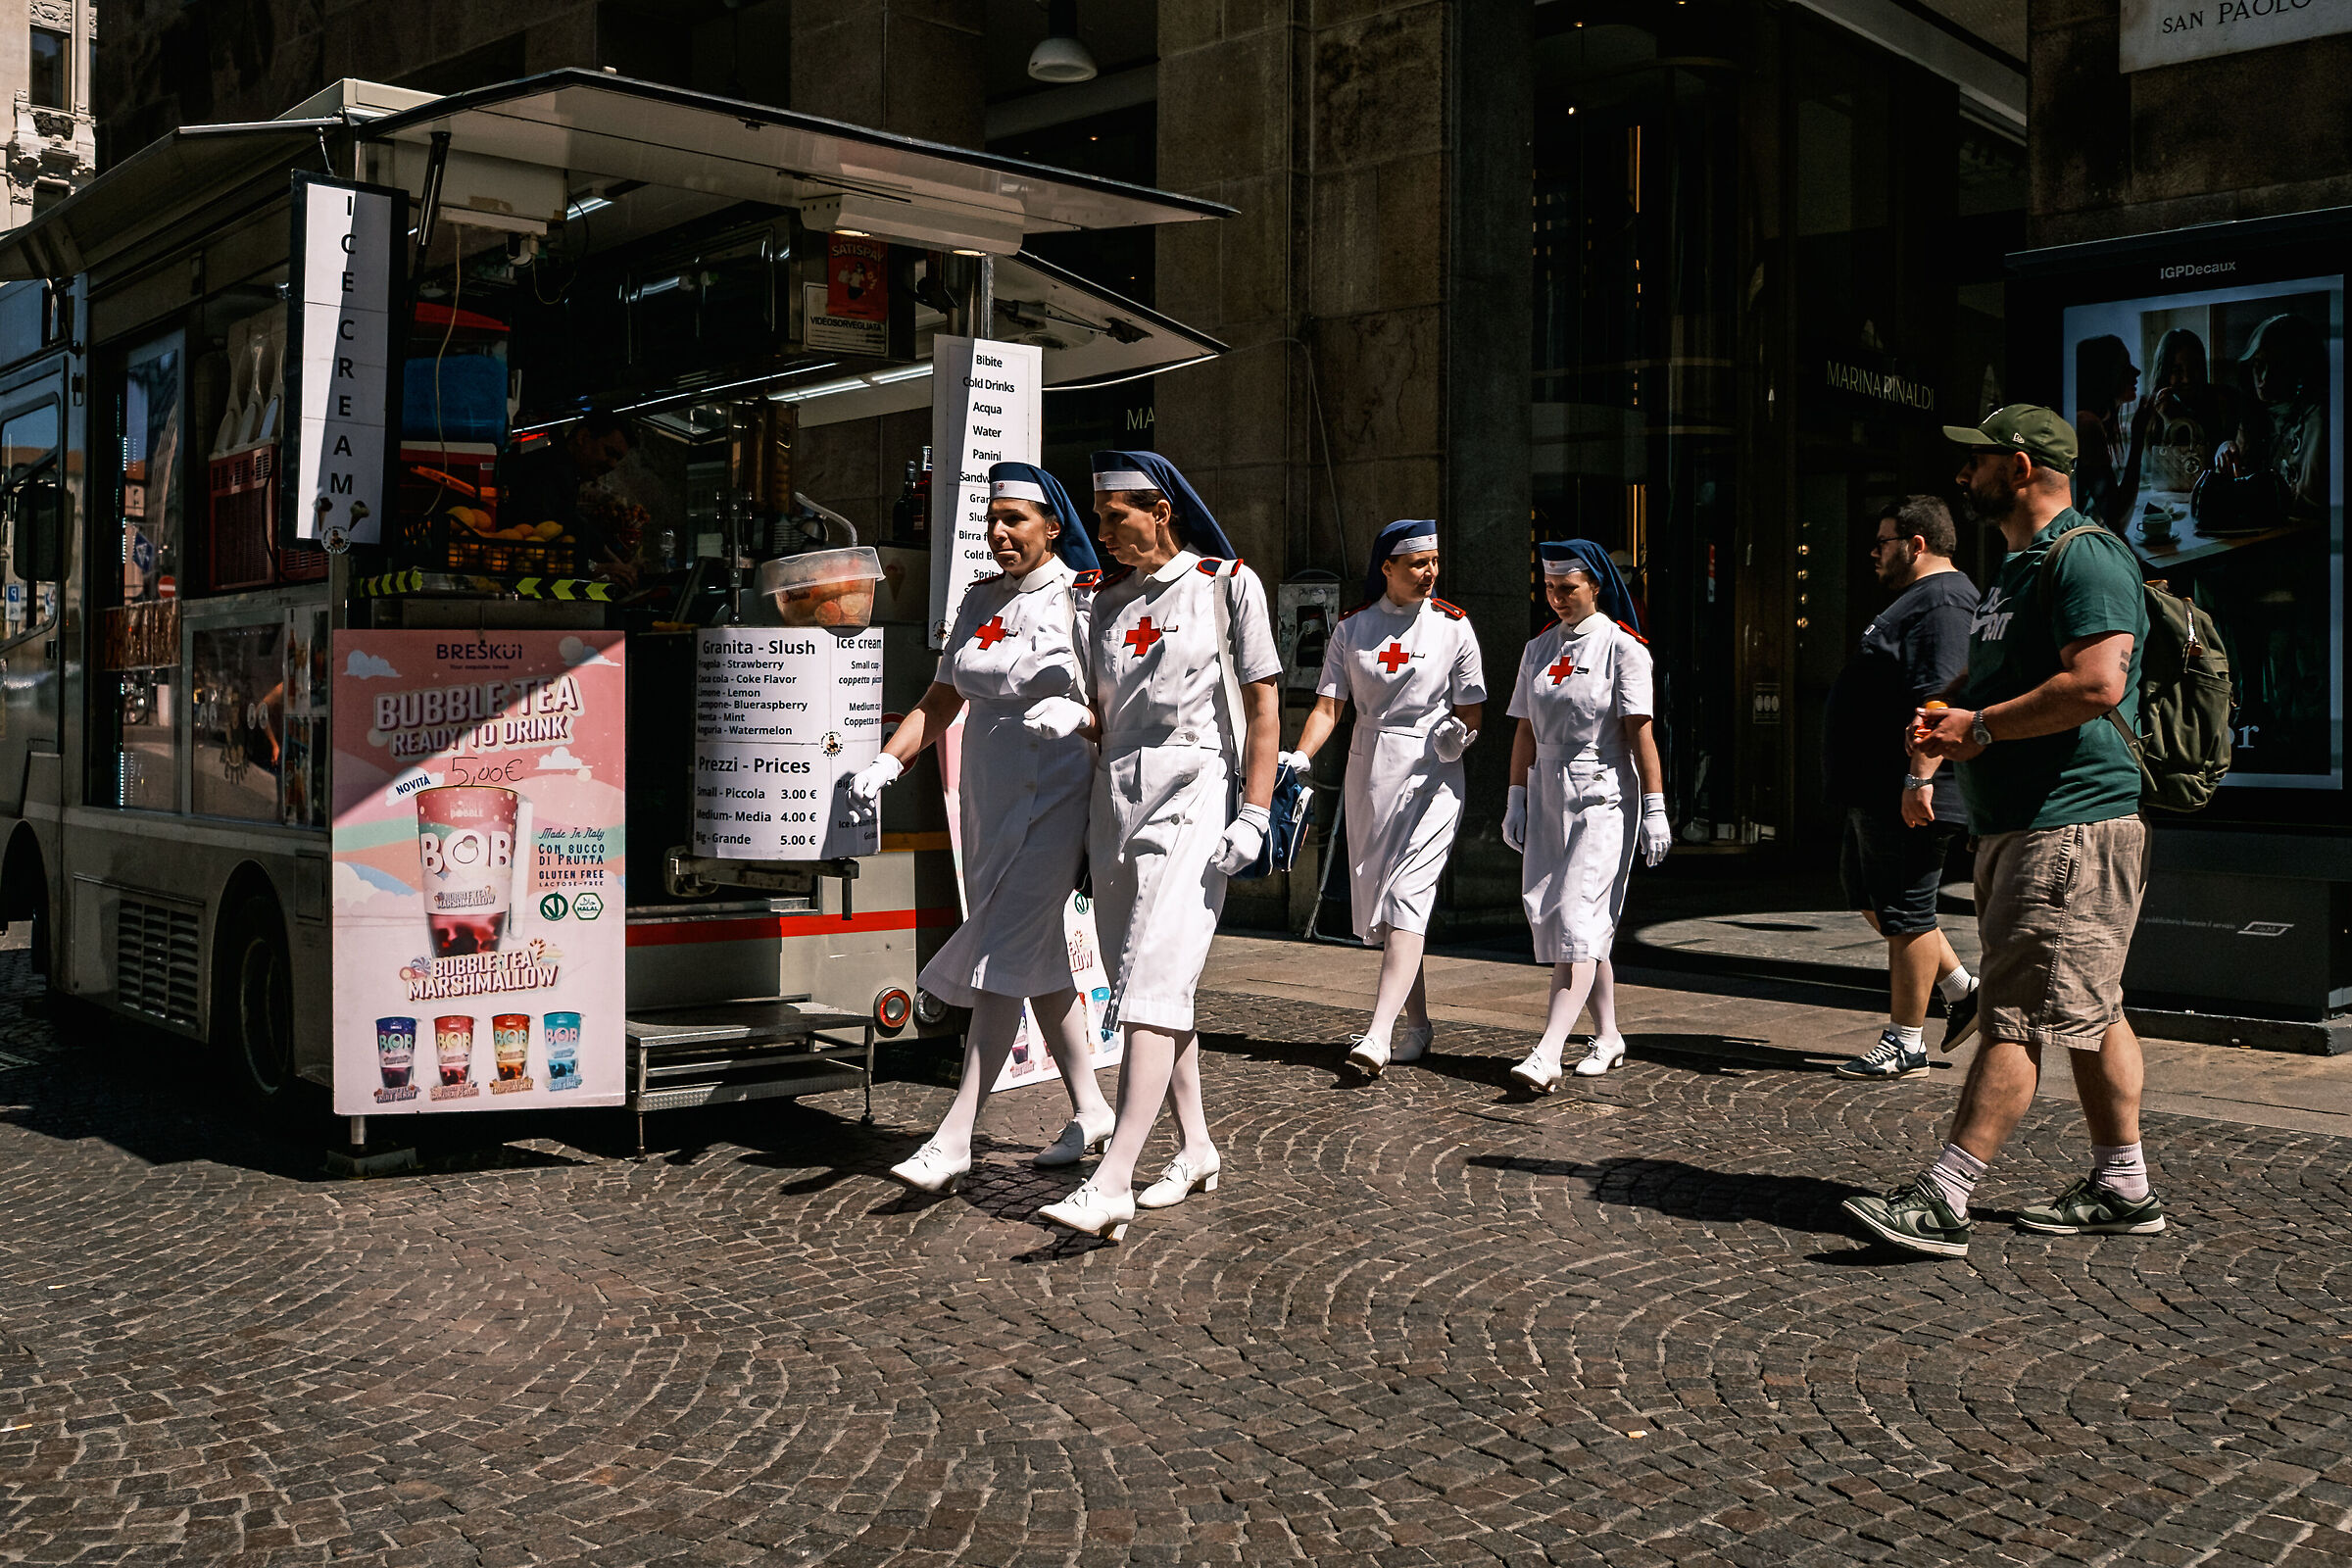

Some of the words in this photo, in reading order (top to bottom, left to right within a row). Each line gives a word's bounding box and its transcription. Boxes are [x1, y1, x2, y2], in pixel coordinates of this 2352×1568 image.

[2162, 11, 2204, 33] SAN
[831, 243, 884, 262] SATISPAY
[2160, 261, 2236, 279] IGPDecaux
[810, 316, 881, 331] VIDEOSORVEGLIATA
[976, 355, 1003, 368] Bibite
[963, 376, 983, 389] Cold
[985, 379, 1014, 392] Drinks
[1827, 360, 1882, 399] MARINA
[1884, 374, 1935, 412] RINALDI
[331, 319, 354, 495] CREAM
[973, 402, 1002, 416] Acqua
[973, 424, 1002, 437] Water
[973, 448, 1002, 462] Panini
[958, 530, 981, 540] Birra
[964, 550, 984, 560] Cold
[703, 640, 754, 655] Granita
[768, 640, 815, 655] Slush
[727, 660, 784, 671] Strawberry
[851, 661, 869, 669] Small
[712, 674, 728, 683] cola
[736, 674, 760, 684] Coke
[763, 674, 797, 684] Flavor
[727, 688, 760, 697] Lemon
[376, 683, 504, 732] BUBBLE
[514, 674, 579, 717] TEA
[734, 700, 808, 711] Blueraspberry
[723, 712, 746, 722] Mint
[844, 717, 874, 727] Coppetta
[393, 726, 463, 758] READY
[471, 722, 498, 748] TO
[503, 714, 568, 744] DRINK
[729, 725, 793, 735] Watermelon
[699, 756, 738, 772] Prezzi
[754, 758, 810, 773] Prices
[396, 773, 431, 796] NOVITÀ
[697, 787, 717, 797] Small
[725, 788, 765, 799] Piccola
[780, 789, 807, 800] 3.00
[809, 790, 817, 799] €
[735, 810, 771, 822] Media
[780, 812, 807, 822] 4.00
[809, 812, 816, 822] €
[539, 827, 565, 840] Made
[570, 827, 582, 839] In
[582, 827, 605, 841] Italy
[712, 833, 752, 845] Grande
[780, 835, 807, 846] 5.00
[808, 835, 816, 846] €
[420, 829, 512, 875] BOB
[539, 870, 575, 879] GLUTEN
[581, 869, 604, 878] FREE
[433, 953, 497, 978] BUBBLE
[500, 951, 534, 971] TEA
[408, 965, 560, 1001] MARSHMALLOW
[378, 1033, 414, 1053] BOB
[437, 1032, 471, 1051] BOB
[495, 1029, 527, 1047] BOB
[546, 1028, 578, 1046] BOB
